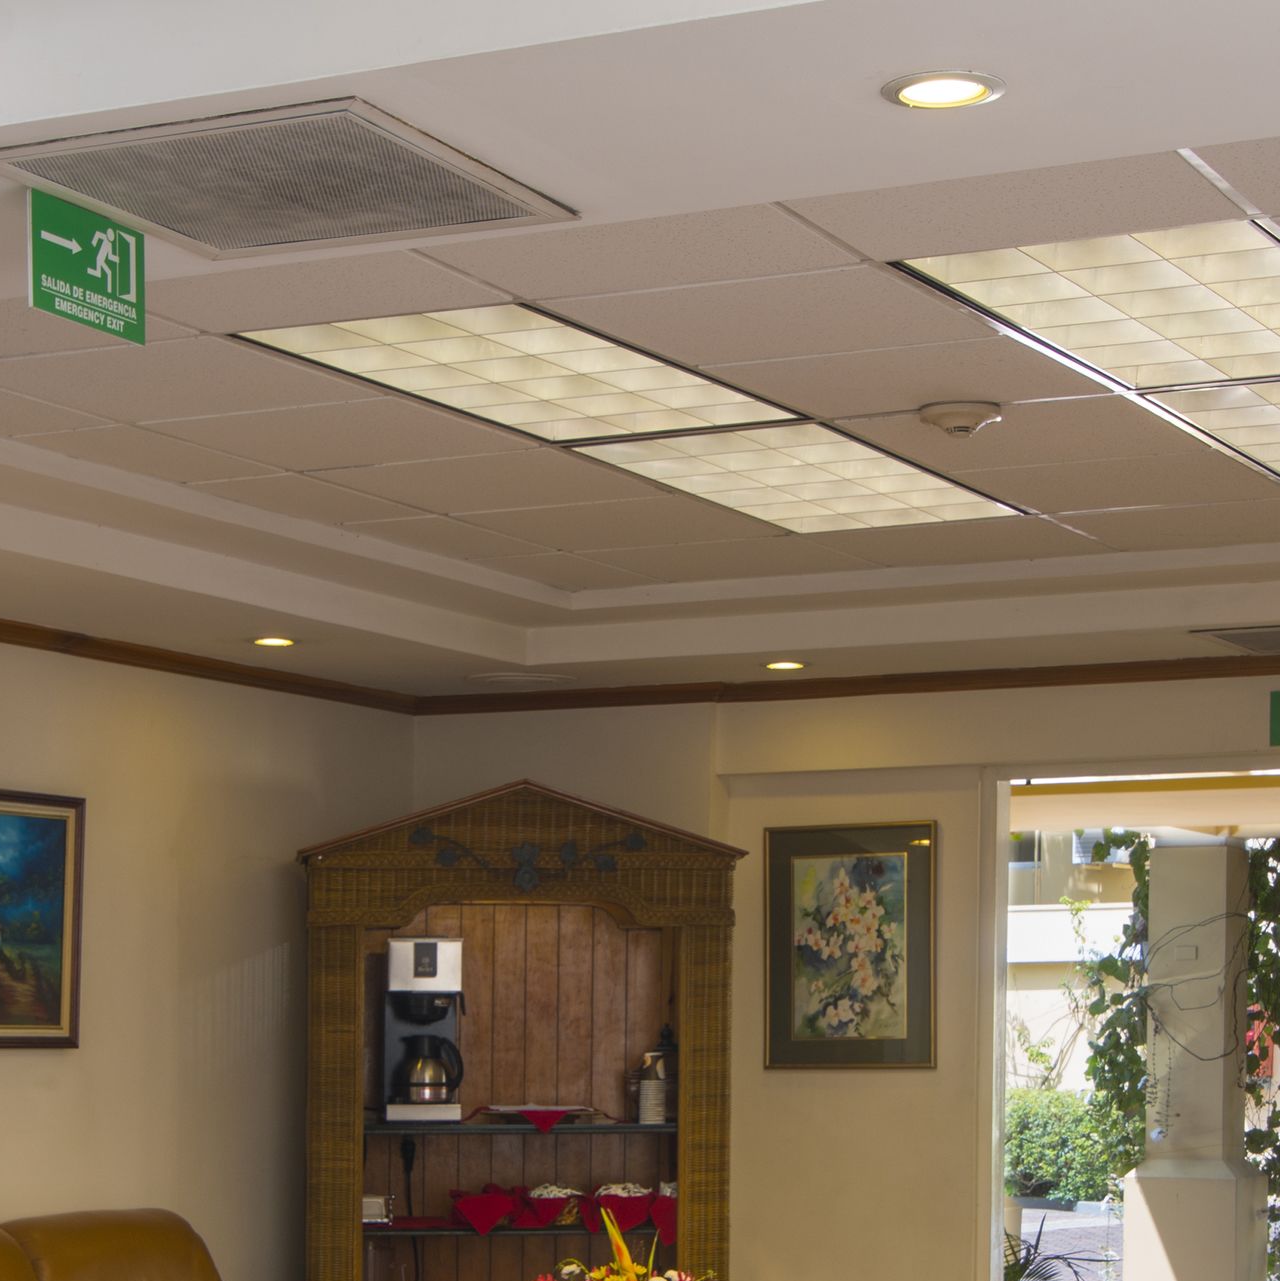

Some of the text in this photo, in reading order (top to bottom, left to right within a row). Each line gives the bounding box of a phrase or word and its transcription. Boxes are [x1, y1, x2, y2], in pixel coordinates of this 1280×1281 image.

[41, 273, 137, 320] SALIDA DE EMERGENCIA
[55, 297, 124, 333] EMERGENCY EXIT
